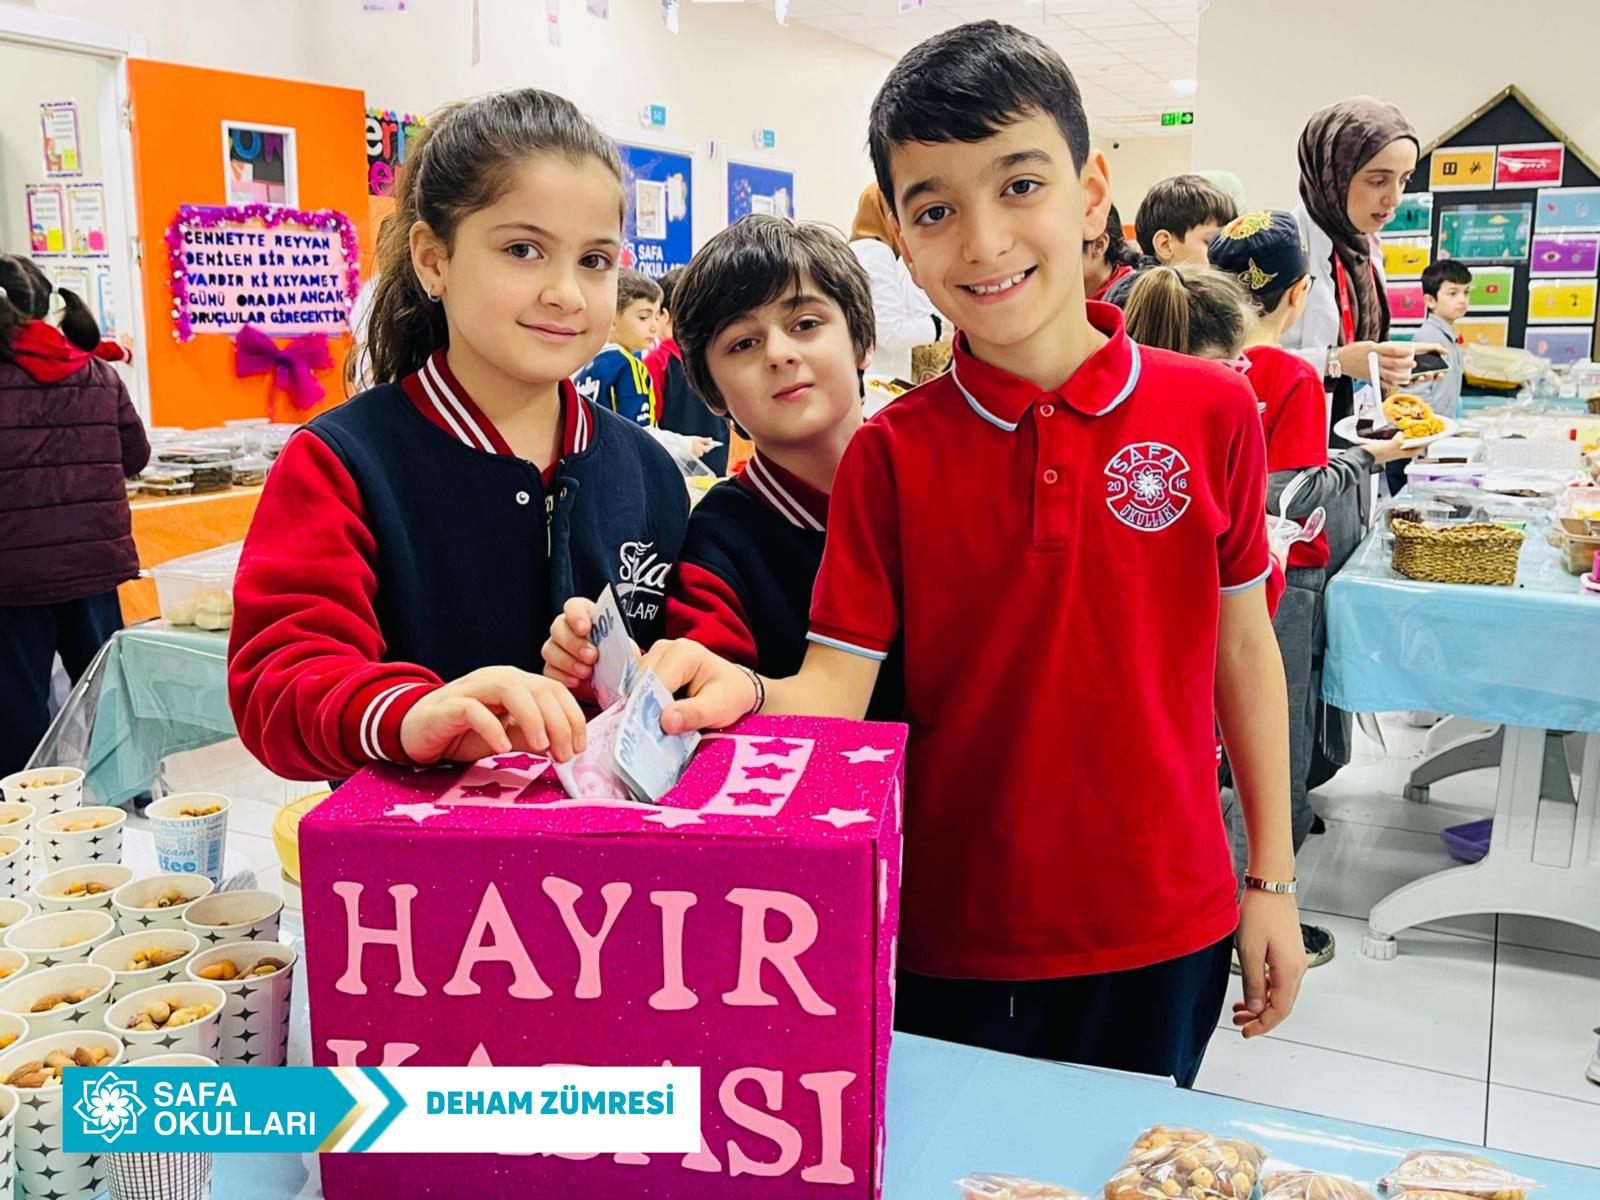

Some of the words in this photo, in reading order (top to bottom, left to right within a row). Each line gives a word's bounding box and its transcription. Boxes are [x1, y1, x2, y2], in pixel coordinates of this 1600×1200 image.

[184, 231, 265, 247] CENNETTE
[275, 235, 330, 249] REYYAN
[185, 250, 252, 266] DENİLEN
[259, 250, 285, 266] BİR
[292, 254, 329, 266] KAPI
[638, 244, 664, 261] SAFA
[187, 273, 244, 287] VARDIR
[251, 272, 269, 287] Kİ
[273, 274, 339, 287] KIYAMET
[189, 289, 225, 306] GÜNÜ
[236, 291, 297, 307] ORADAN
[300, 290, 344, 303] ANCAK
[189, 310, 265, 327] ORUÇLULAR
[271, 307, 347, 324] GİRECEKTİR
[1112, 445, 1177, 472] SAFA
[1107, 481, 1121, 491] 20
[1176, 478, 1187, 489] 16
[1120, 503, 1179, 527] OKULLARI
[332, 876, 837, 1016] HAYIR
